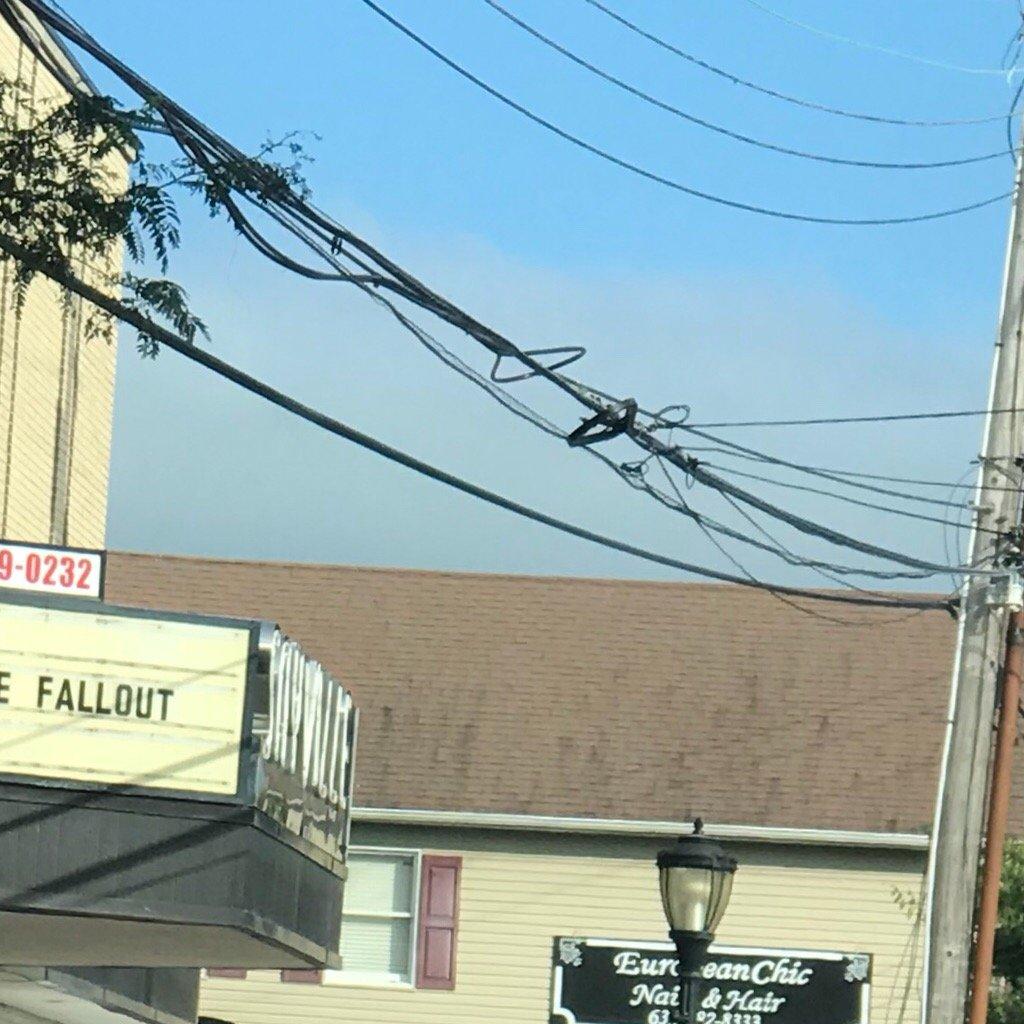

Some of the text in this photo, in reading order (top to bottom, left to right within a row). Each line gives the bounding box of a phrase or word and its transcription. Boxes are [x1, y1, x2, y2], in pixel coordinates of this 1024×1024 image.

[37, 676, 174, 720] FALLOUT
[701, 987, 722, 1010] &
[722, 990, 786, 1013] Hair
